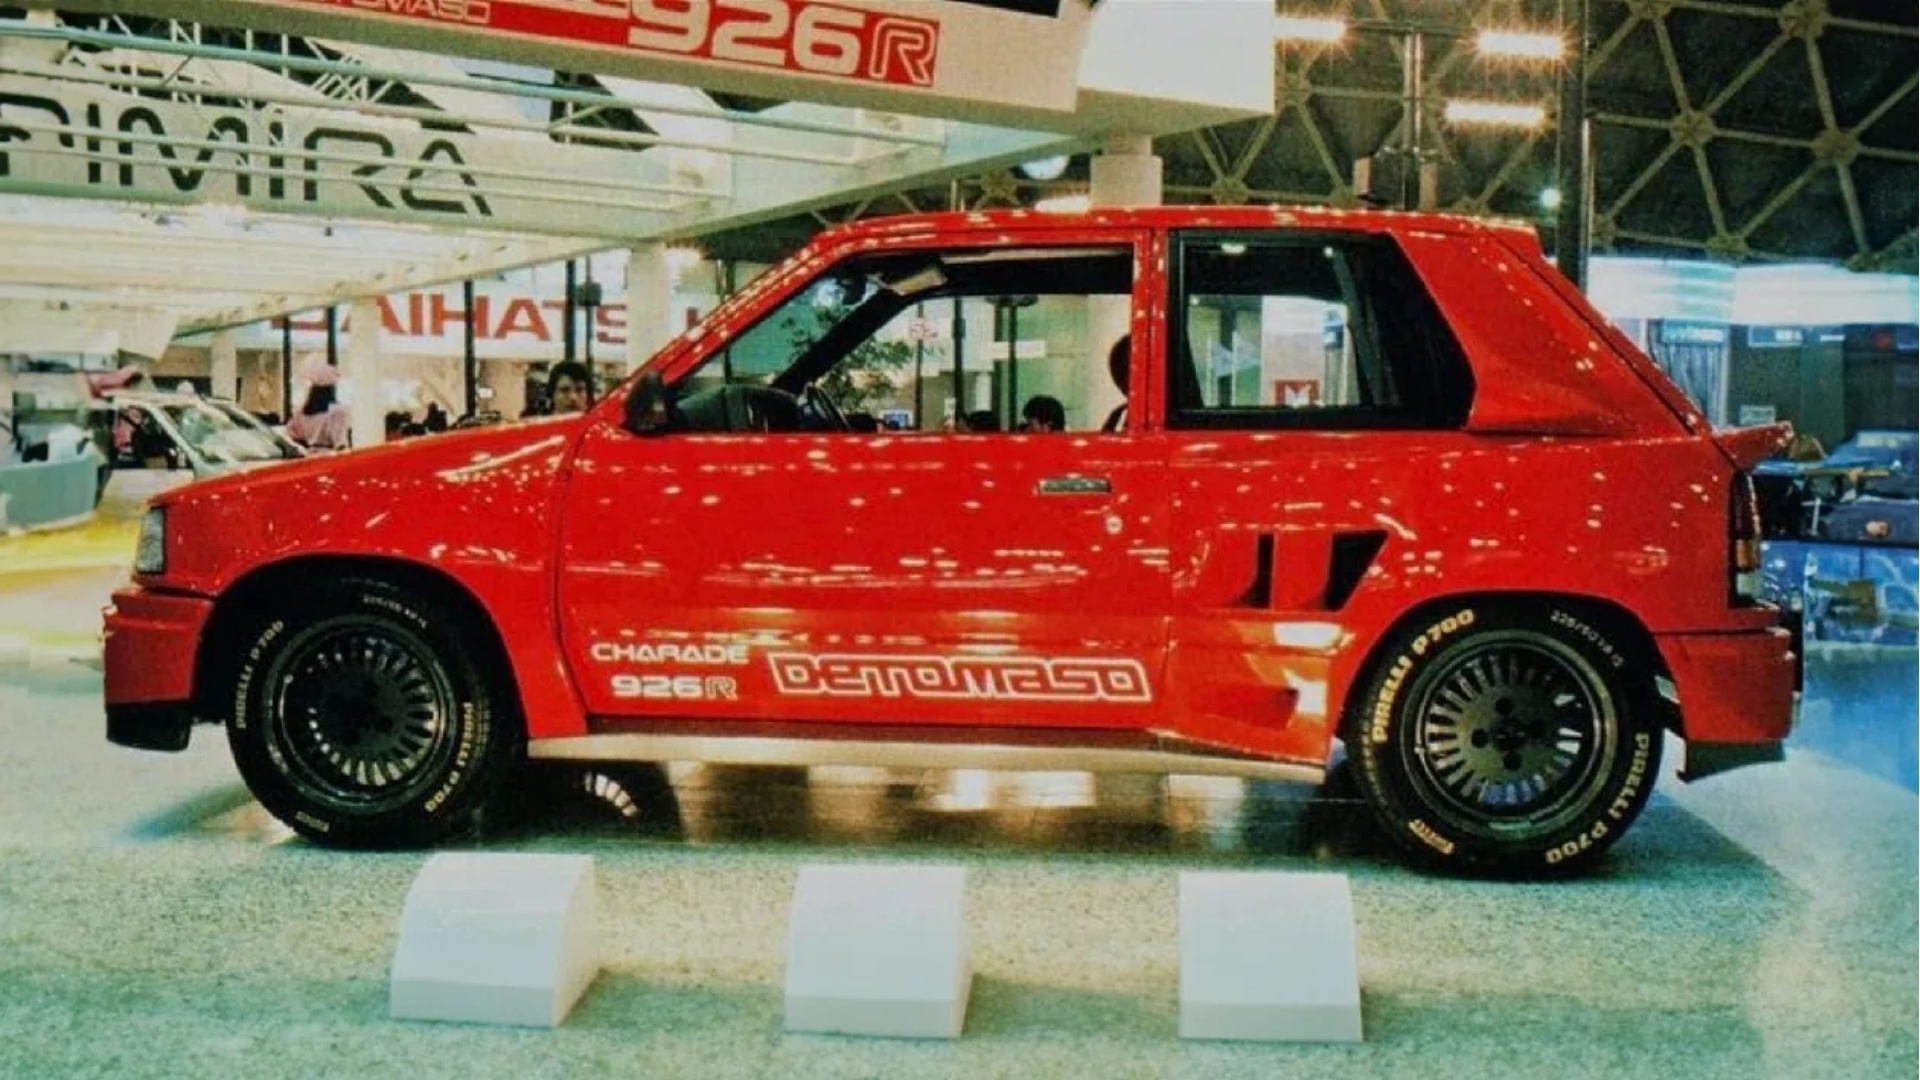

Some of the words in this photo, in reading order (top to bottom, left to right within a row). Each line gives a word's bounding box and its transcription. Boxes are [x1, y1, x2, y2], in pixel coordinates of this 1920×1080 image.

[338, 0, 490, 24] MASO
[270, 293, 700, 344] AIHAS
[591, 643, 750, 665] CHARADE
[610, 674, 738, 701] 926R
[1372, 655, 1412, 743] PIRELLI
[1608, 732, 1649, 819] PIRELLI
